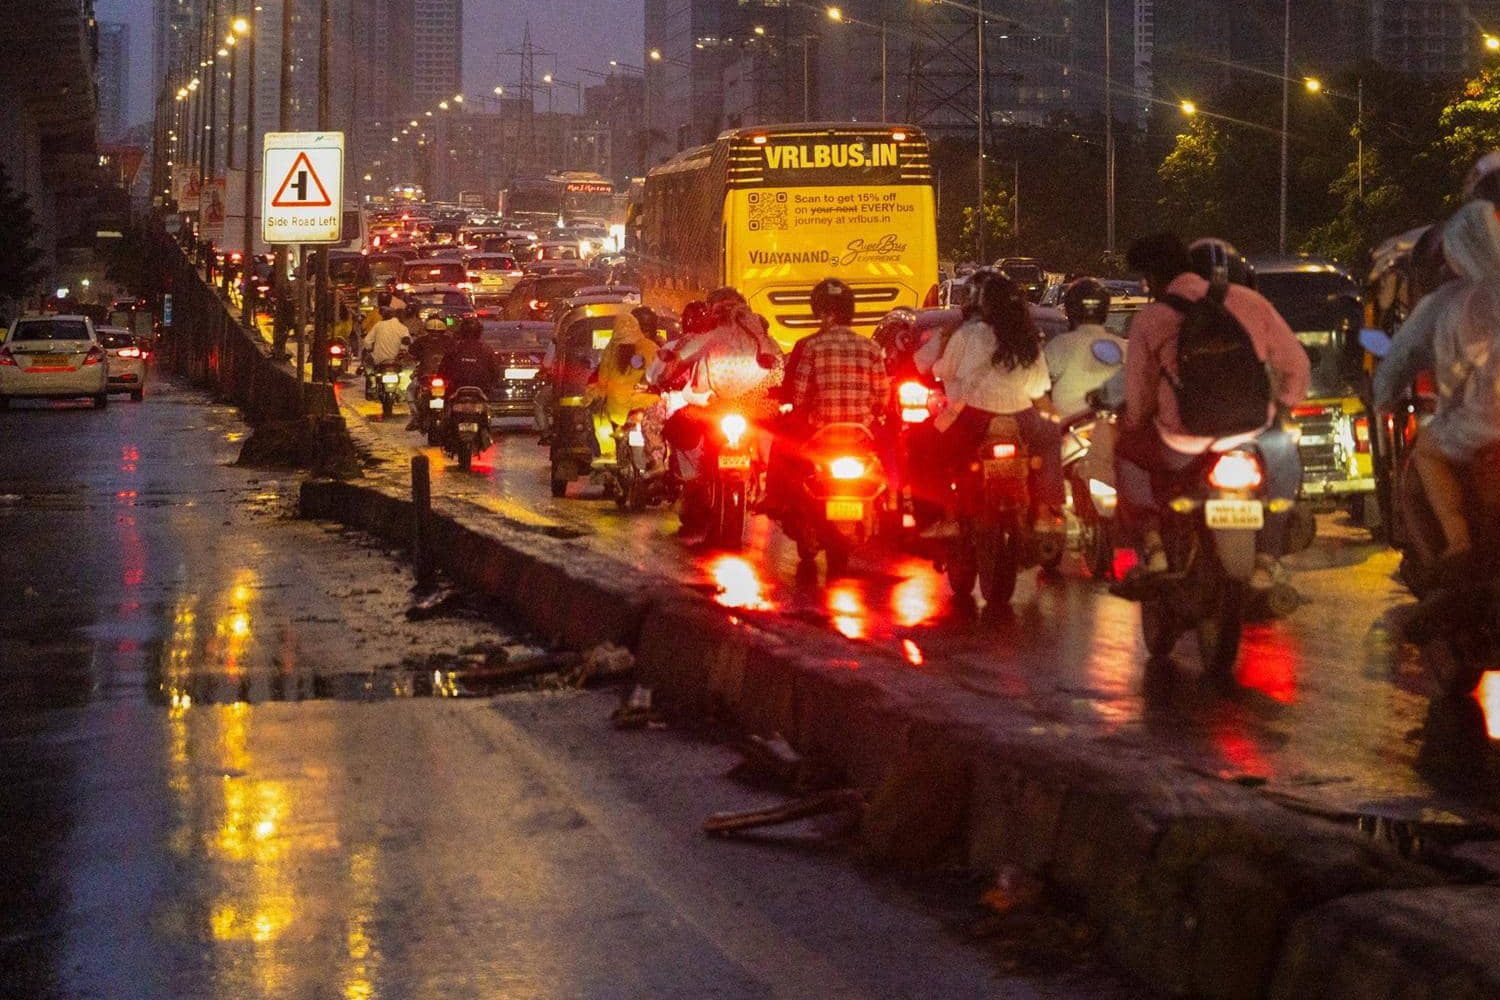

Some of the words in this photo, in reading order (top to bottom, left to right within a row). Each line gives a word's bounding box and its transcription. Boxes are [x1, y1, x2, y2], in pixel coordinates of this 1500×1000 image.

[764, 143, 898, 169] VRLBUS.IN
[794, 195, 821, 203] Scan
[824, 194, 835, 203] to
[838, 194, 854, 205] get
[858, 193, 880, 202] 15%
[883, 193, 897, 201] off
[861, 204, 895, 212] EVERY
[896, 203, 915, 212] bus
[268, 217, 288, 227] Side
[292, 217, 315, 227] Road
[319, 216, 337, 226] Left
[794, 216, 832, 227] journey
[835, 216, 845, 224] at
[749, 250, 829, 264] VIJAYANAND
